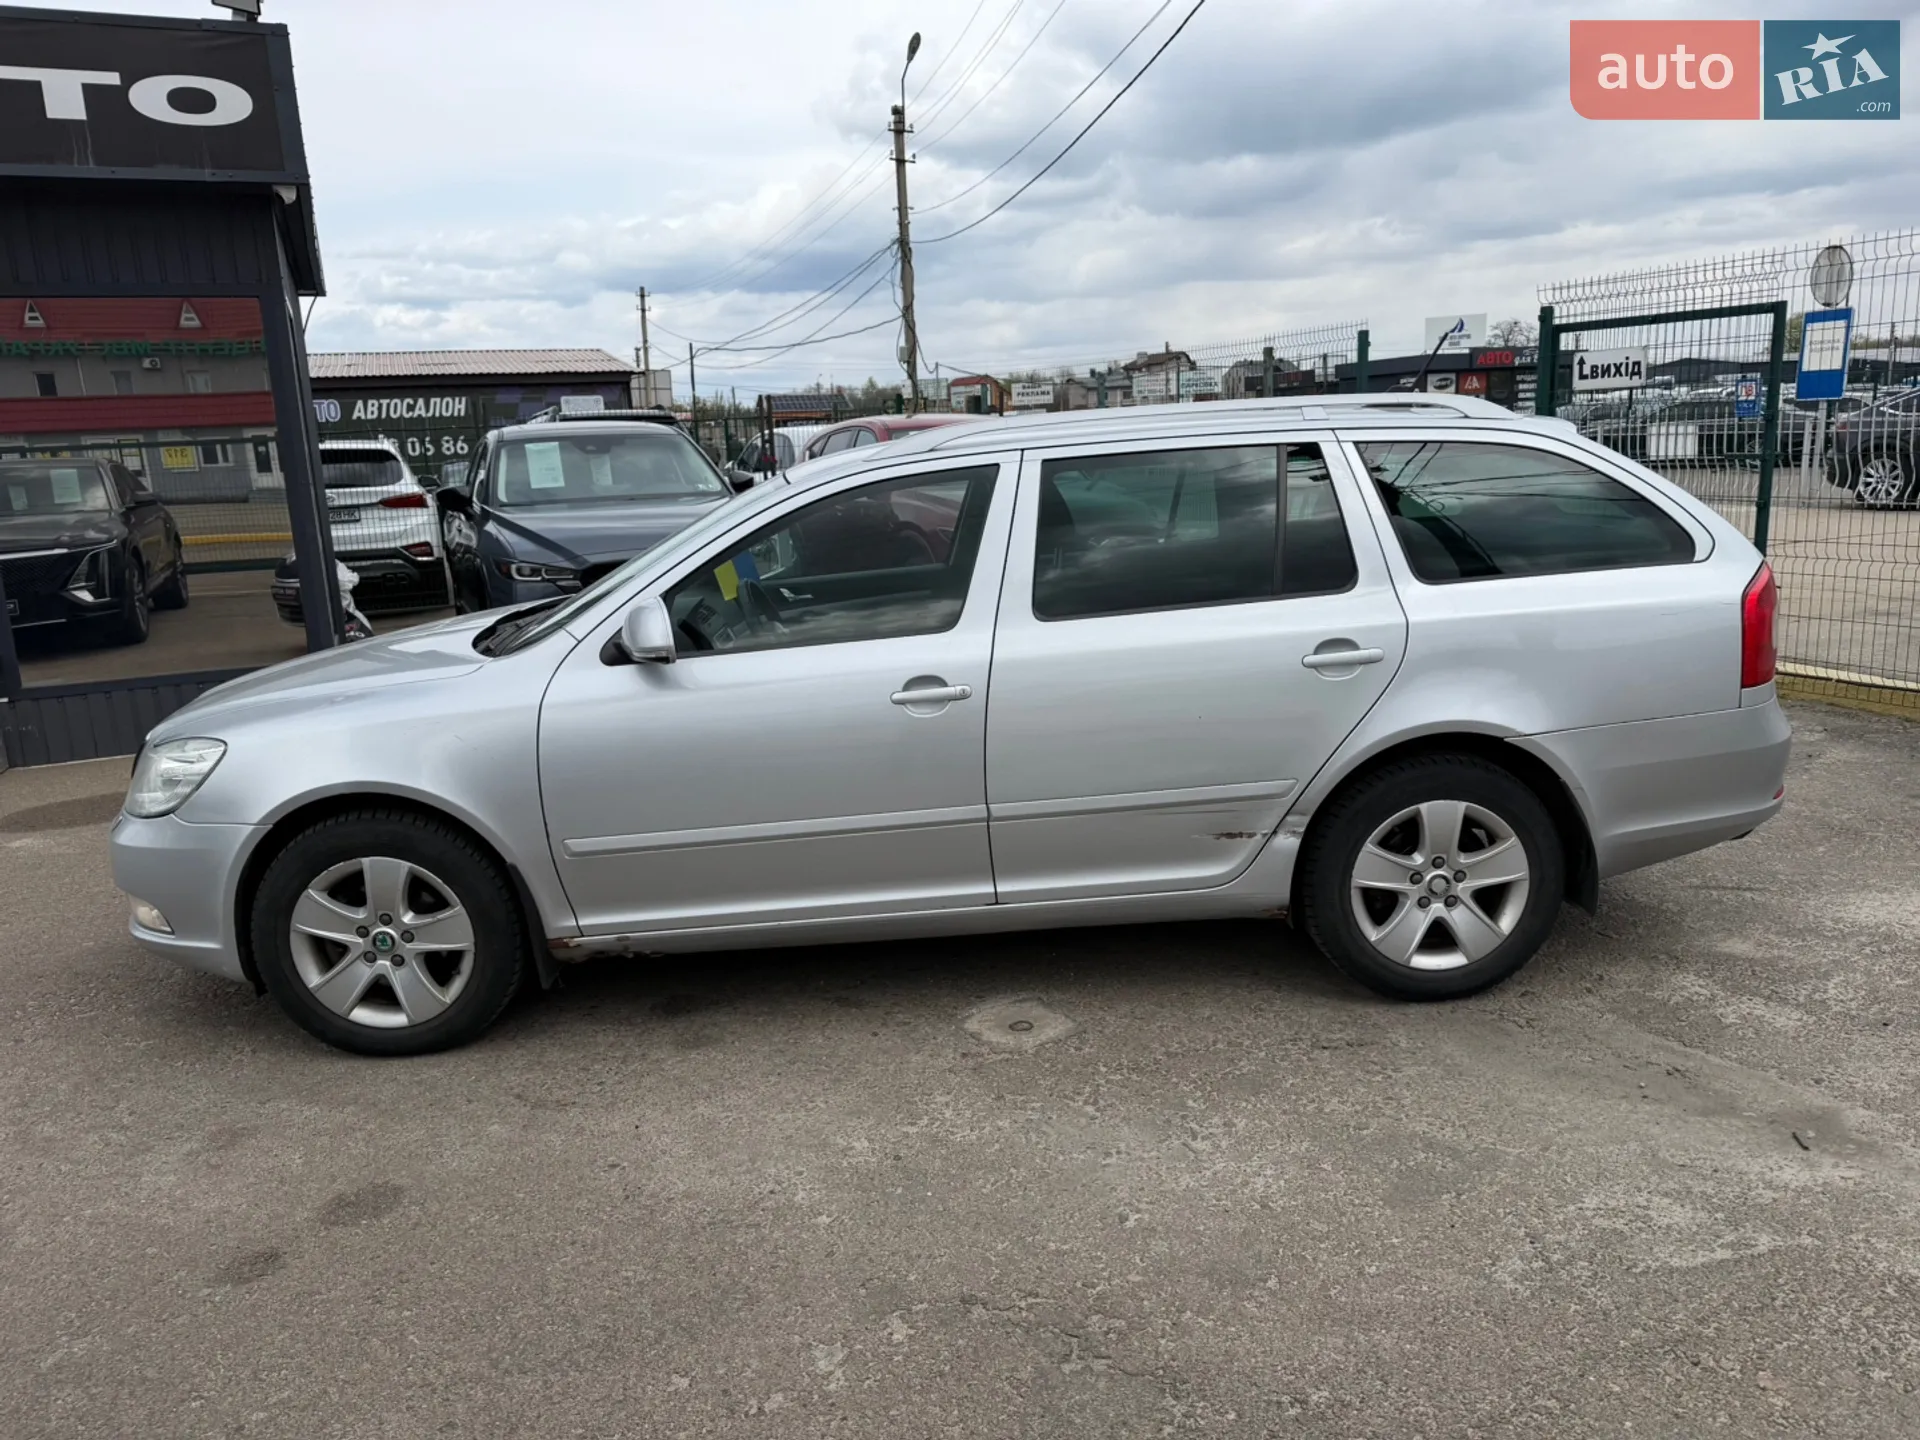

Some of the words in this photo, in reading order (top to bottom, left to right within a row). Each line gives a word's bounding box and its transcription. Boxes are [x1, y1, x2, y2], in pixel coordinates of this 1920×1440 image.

[1476, 351, 1513, 365] АВТО
[1590, 356, 1642, 381] вихід
[352, 396, 467, 420] АВТОСАЛОН
[440, 435, 469, 456] 86
